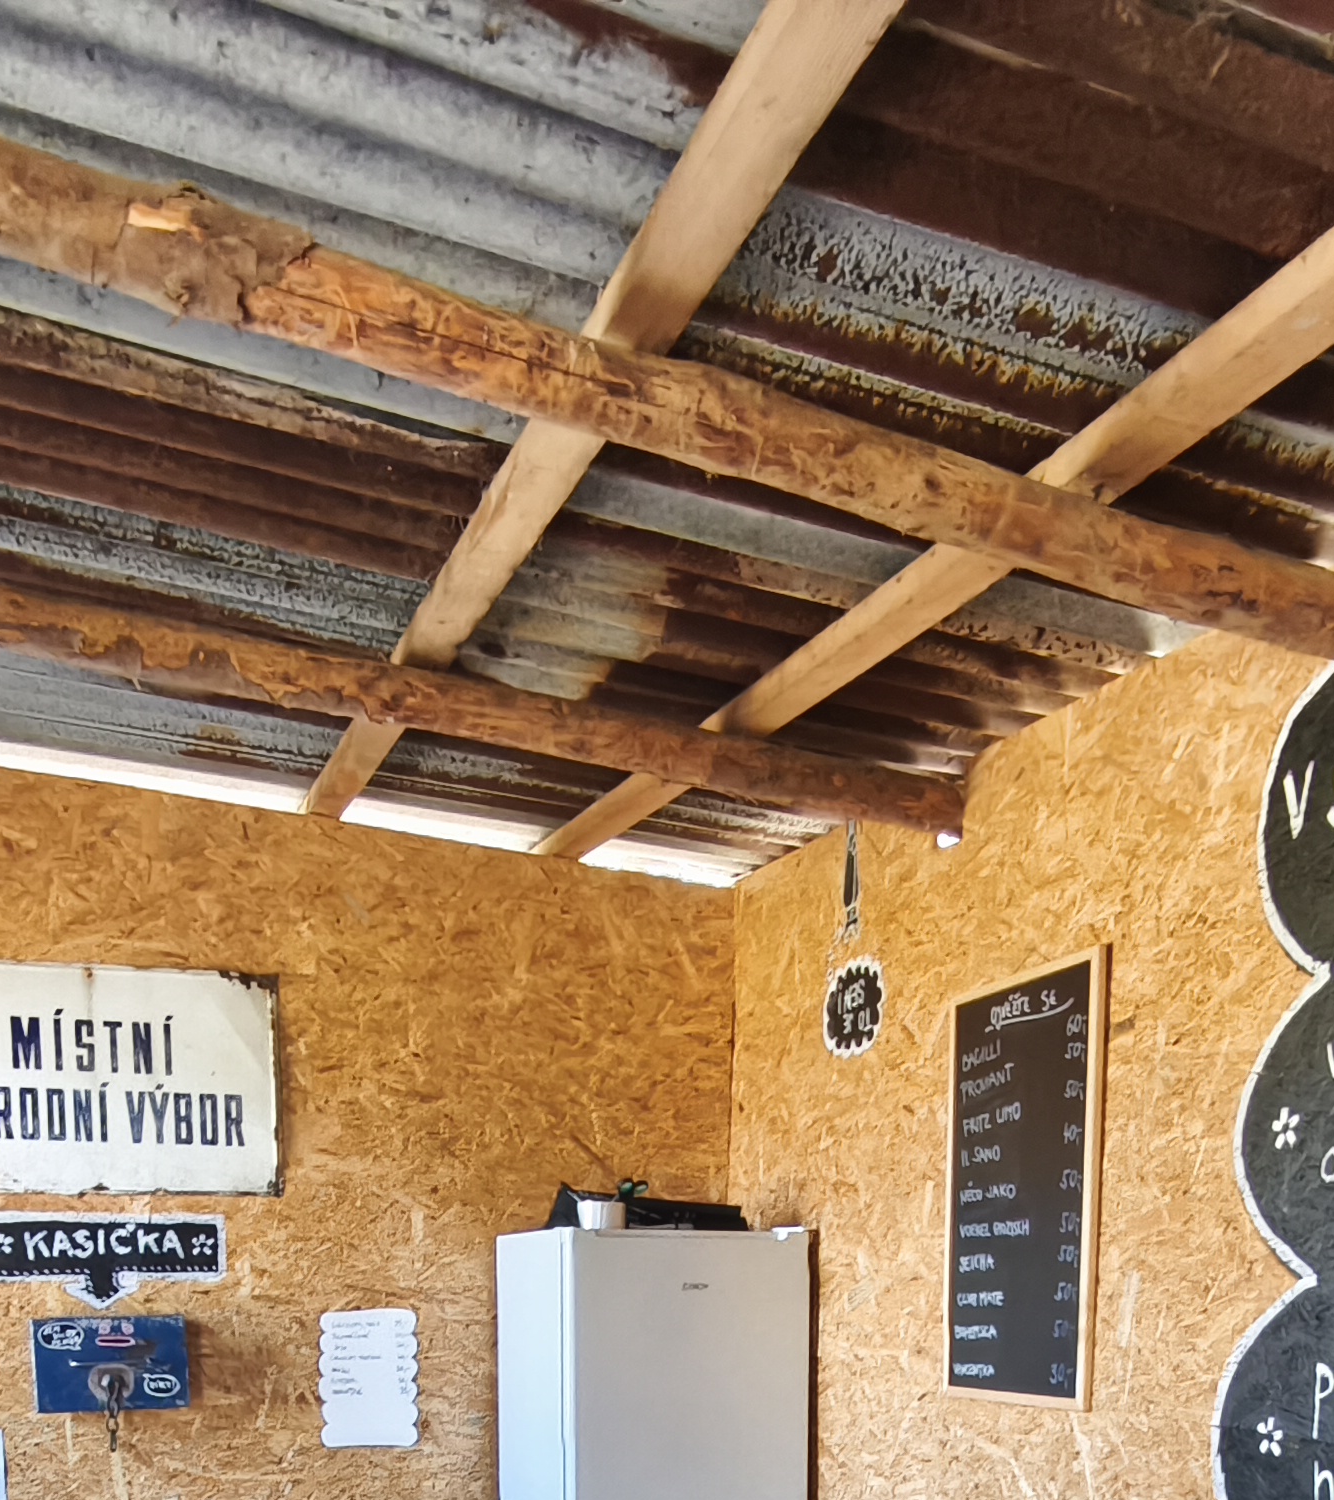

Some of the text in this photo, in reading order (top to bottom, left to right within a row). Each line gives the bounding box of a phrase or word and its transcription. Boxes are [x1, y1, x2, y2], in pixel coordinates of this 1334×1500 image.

[1282, 760, 1315, 840] V
[9, 1008, 174, 1075] MÍSTNÍ
[125, 1083, 246, 1147] VÝBOR
[23, 1219, 185, 1261] KASIČKA
